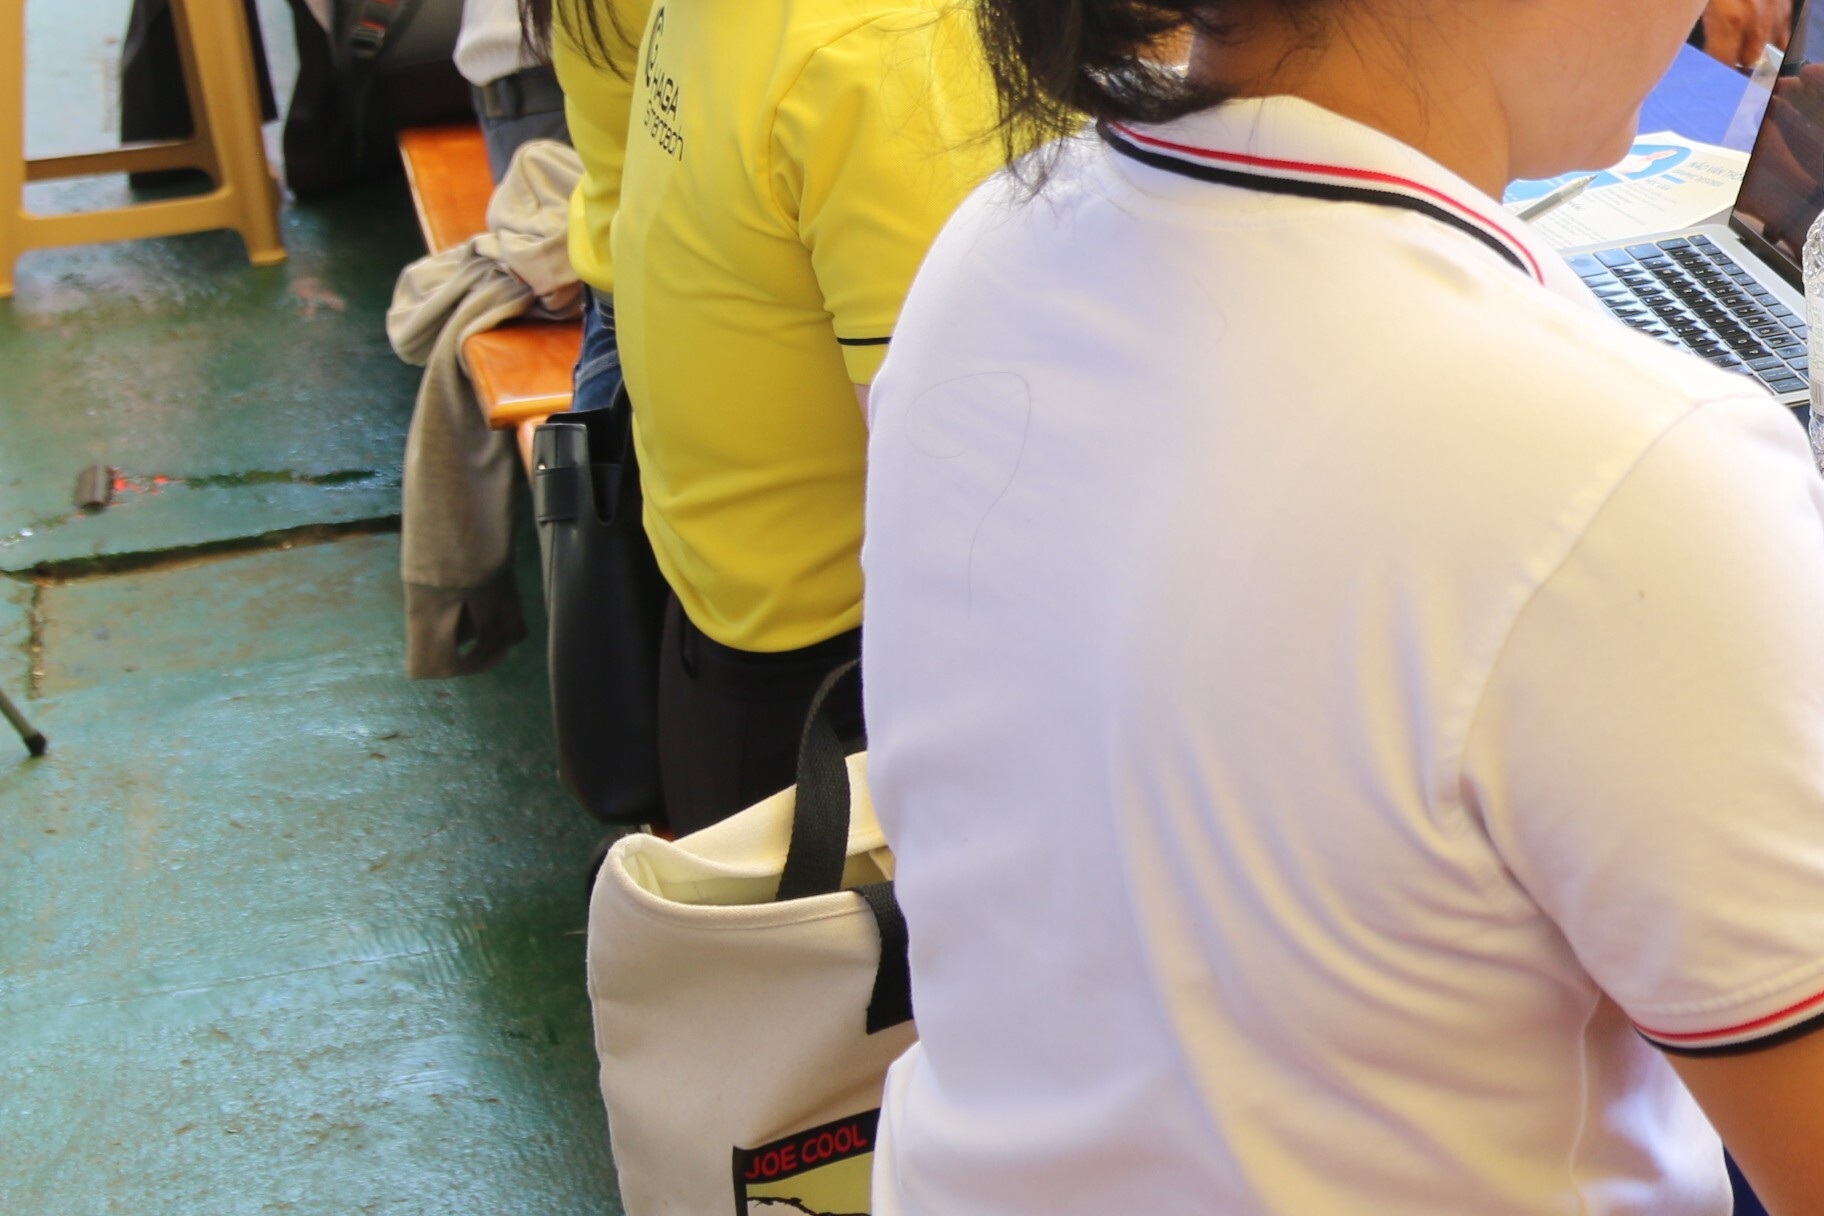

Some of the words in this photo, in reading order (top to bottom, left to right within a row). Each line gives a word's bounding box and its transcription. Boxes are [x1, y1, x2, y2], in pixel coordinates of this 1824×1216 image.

[650, 69, 681, 122] HAGA
[745, 1149, 798, 1180] JOE
[801, 1124, 868, 1166] COOL
